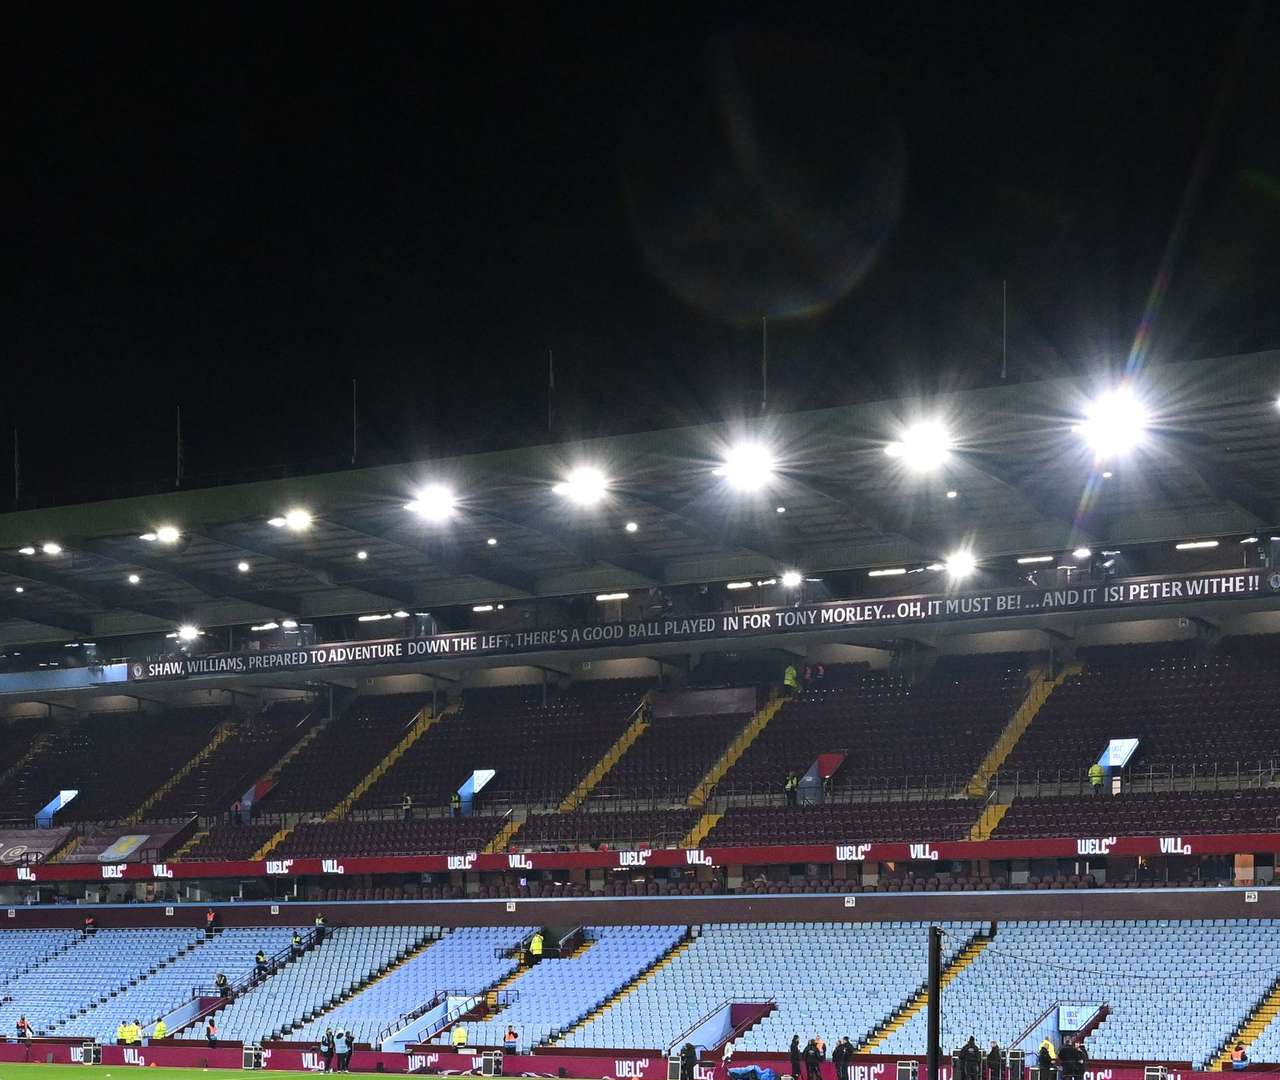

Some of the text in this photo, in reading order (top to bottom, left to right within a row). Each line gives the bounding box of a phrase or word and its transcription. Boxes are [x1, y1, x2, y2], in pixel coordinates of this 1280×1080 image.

[148, 661, 185, 676] SHAW,
[187, 657, 246, 673] WILLIAMS,
[249, 652, 308, 669] PREPARED
[310, 650, 327, 663] TO
[328, 643, 402, 662] ADVENTURE
[408, 638, 450, 655] DOWN
[452, 637, 477, 651] THE
[516, 630, 568, 646] THERE'S
[571, 629, 580, 642] A
[583, 625, 623, 640] GOOD
[629, 621, 661, 637] BALL
[665, 618, 716, 634] PLAYED
[723, 617, 739, 631] IN
[743, 614, 771, 629] FOR
[776, 610, 817, 626] TONY
[928, 600, 942, 616] IT
[946, 597, 991, 614] MUST
[1042, 590, 1079, 607] AND
[1083, 589, 1096, 603] IT
[1104, 586, 1124, 602] IS!
[1129, 581, 1182, 600] PETER
